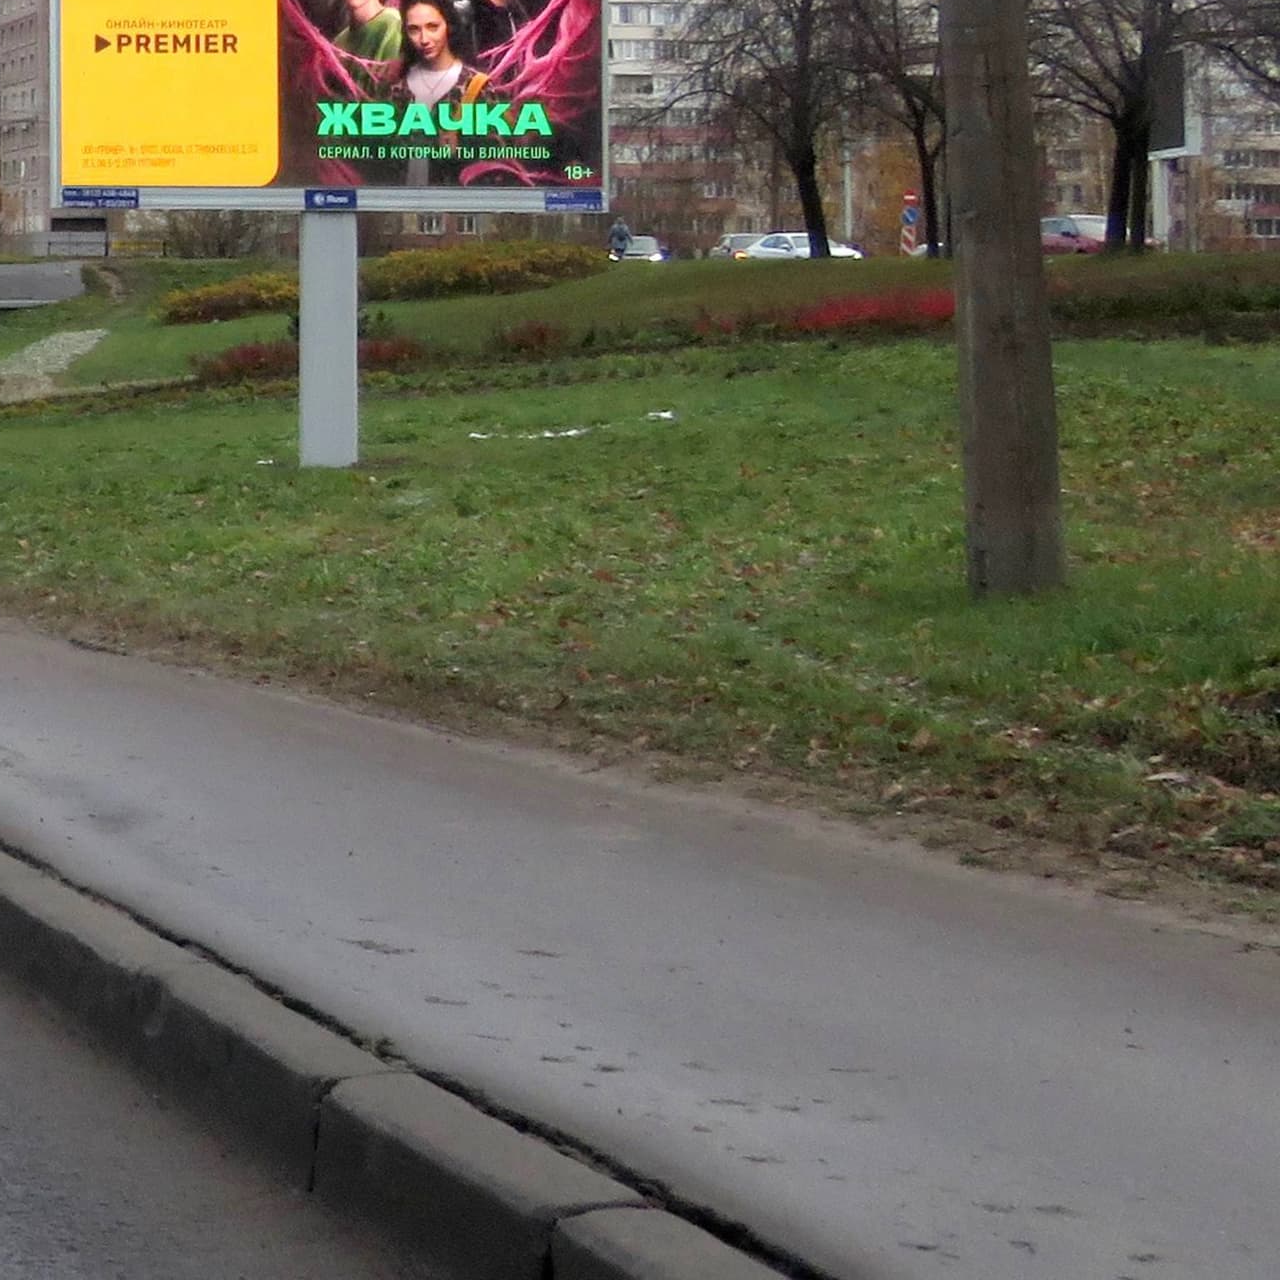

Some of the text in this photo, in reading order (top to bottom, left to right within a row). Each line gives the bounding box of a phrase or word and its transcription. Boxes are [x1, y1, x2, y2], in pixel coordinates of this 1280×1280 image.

[105, 18, 228, 30] ОНЛАЙН-КИНОТЕАТР
[116, 33, 238, 54] PREMIER
[317, 102, 553, 136] ЖВАЧКА
[378, 146, 386, 159] В
[390, 144, 452, 159] КОТОРЫЙ
[456, 146, 474, 159] ТЫ
[479, 146, 550, 159] ВЛИПНЕШЬ
[564, 166, 594, 180] 18+
